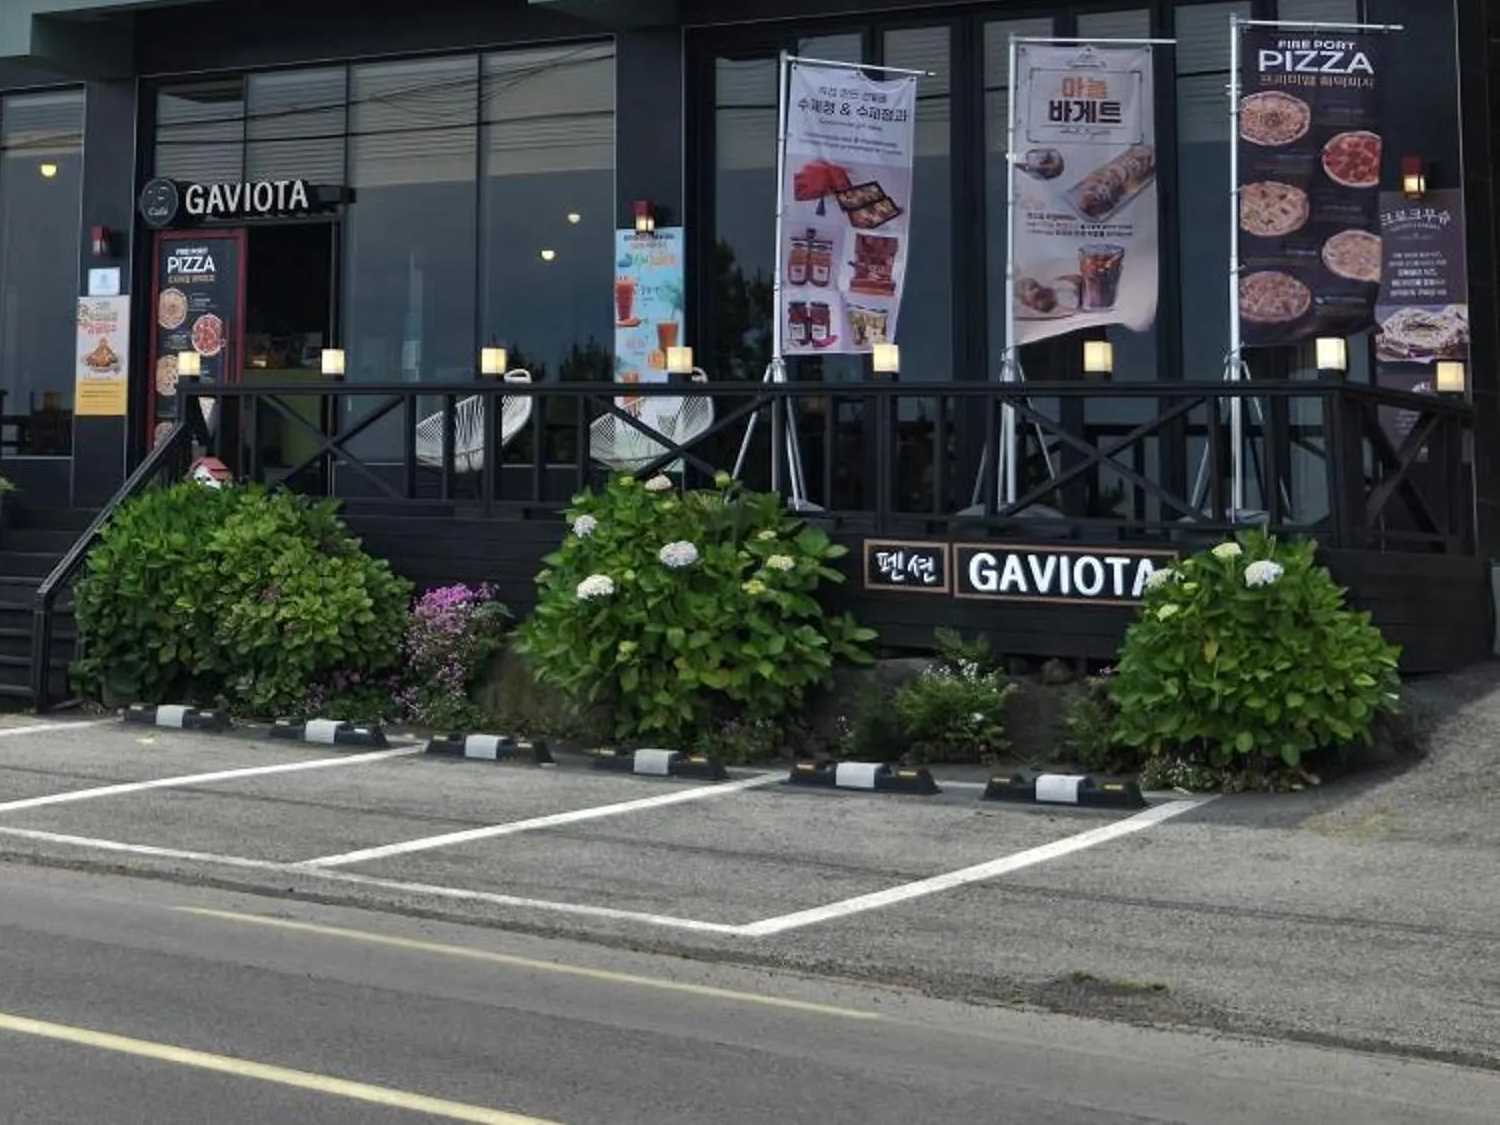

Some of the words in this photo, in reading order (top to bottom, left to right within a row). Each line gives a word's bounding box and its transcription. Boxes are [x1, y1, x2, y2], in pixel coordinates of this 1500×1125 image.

[1259, 49, 1375, 74] PIZZA
[840, 102, 851, 116] &
[1049, 100, 1122, 124] 바게트
[185, 180, 309, 215] GAVIOTA
[167, 255, 216, 274] PIZZA
[876, 551, 937, 583] 펜션
[969, 552, 1160, 597] GAVIOTA
